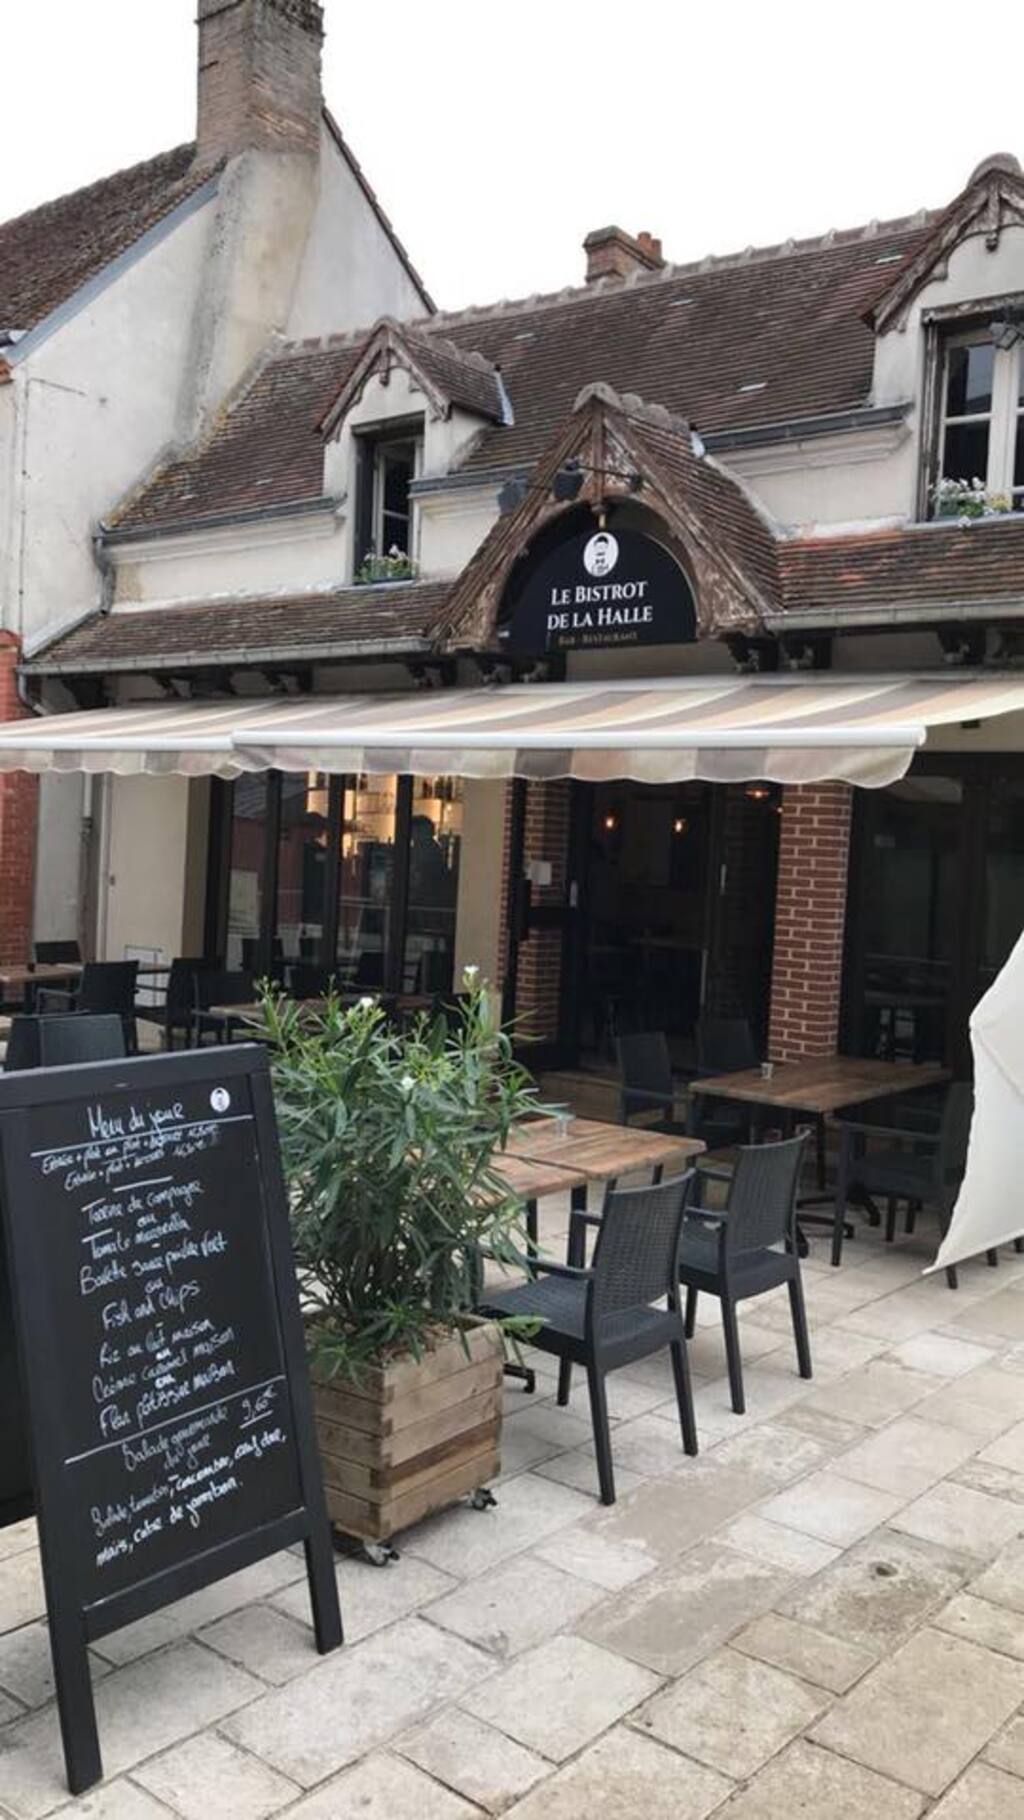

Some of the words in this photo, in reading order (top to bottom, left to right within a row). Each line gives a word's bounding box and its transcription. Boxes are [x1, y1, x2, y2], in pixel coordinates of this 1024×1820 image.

[551, 588, 571, 606] LE
[575, 581, 648, 603] BISTROT
[547, 613, 570, 630] DE
[573, 611, 593, 627] LA
[598, 606, 653, 626] HALLE
[87, 1104, 124, 1139] Menu
[129, 1106, 145, 1131] du
[127, 1195, 144, 1213] de
[137, 1213, 157, 1228] ou
[145, 1278, 164, 1293] ou
[102, 1300, 132, 1330] Fish
[134, 1295, 156, 1318] and
[156, 1348, 172, 1360] ou
[155, 1373, 177, 1389] ou
[100, 1404, 131, 1437] Flan
[170, 1505, 184, 1524] de
